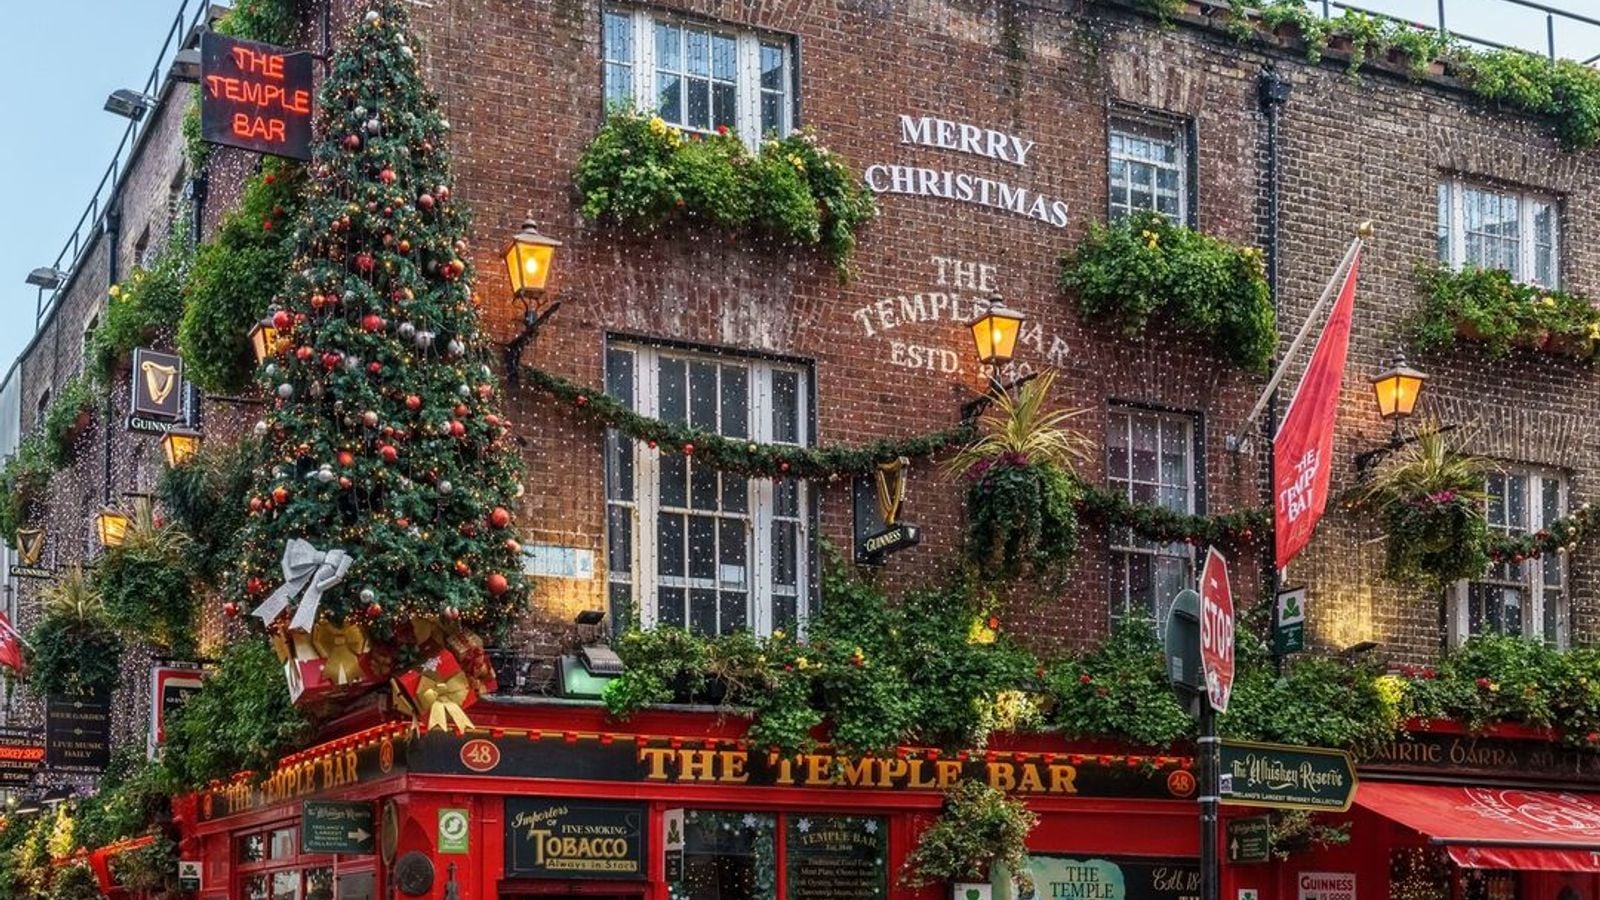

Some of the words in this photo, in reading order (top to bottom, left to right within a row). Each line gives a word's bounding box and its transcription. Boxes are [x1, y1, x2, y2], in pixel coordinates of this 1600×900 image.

[232, 46, 284, 78] THE
[206, 74, 309, 113] TEMPLE
[233, 112, 285, 142] BAR
[899, 114, 1035, 167] MERRY
[864, 163, 1069, 228] CHRISTMAS
[931, 255, 999, 293] THE
[852, 291, 992, 338] TEMPLE
[1019, 319, 1070, 369] AR
[131, 416, 176, 432] GUINNE
[1295, 448, 1316, 475] THE
[866, 528, 902, 552] GUINNESS
[1203, 596, 1232, 662] STOP
[323, 750, 359, 789] BAR
[467, 745, 491, 769] 48
[641, 748, 749, 782] THE
[770, 753, 963, 788] TEMPLE
[986, 762, 1078, 793] BAR
[1173, 773, 1190, 792] 48
[1246, 753, 1299, 790] Whiskey
[1299, 761, 1343, 793] Reserve
[511, 805, 569, 829] Importers
[561, 824, 583, 834] FINE
[584, 826, 628, 836] SMOKING
[526, 829, 628, 866] TOBACCO
[801, 832, 850, 846] TEMPLE
[853, 833, 878, 849] BAR
[547, 859, 588, 870] Always
[591, 861, 602, 869] in
[604, 861, 636, 871] Stock
[1066, 866, 1099, 882] THE
[1050, 883, 1114, 899] TEMPLE
[1300, 876, 1353, 891] GUINNESS
